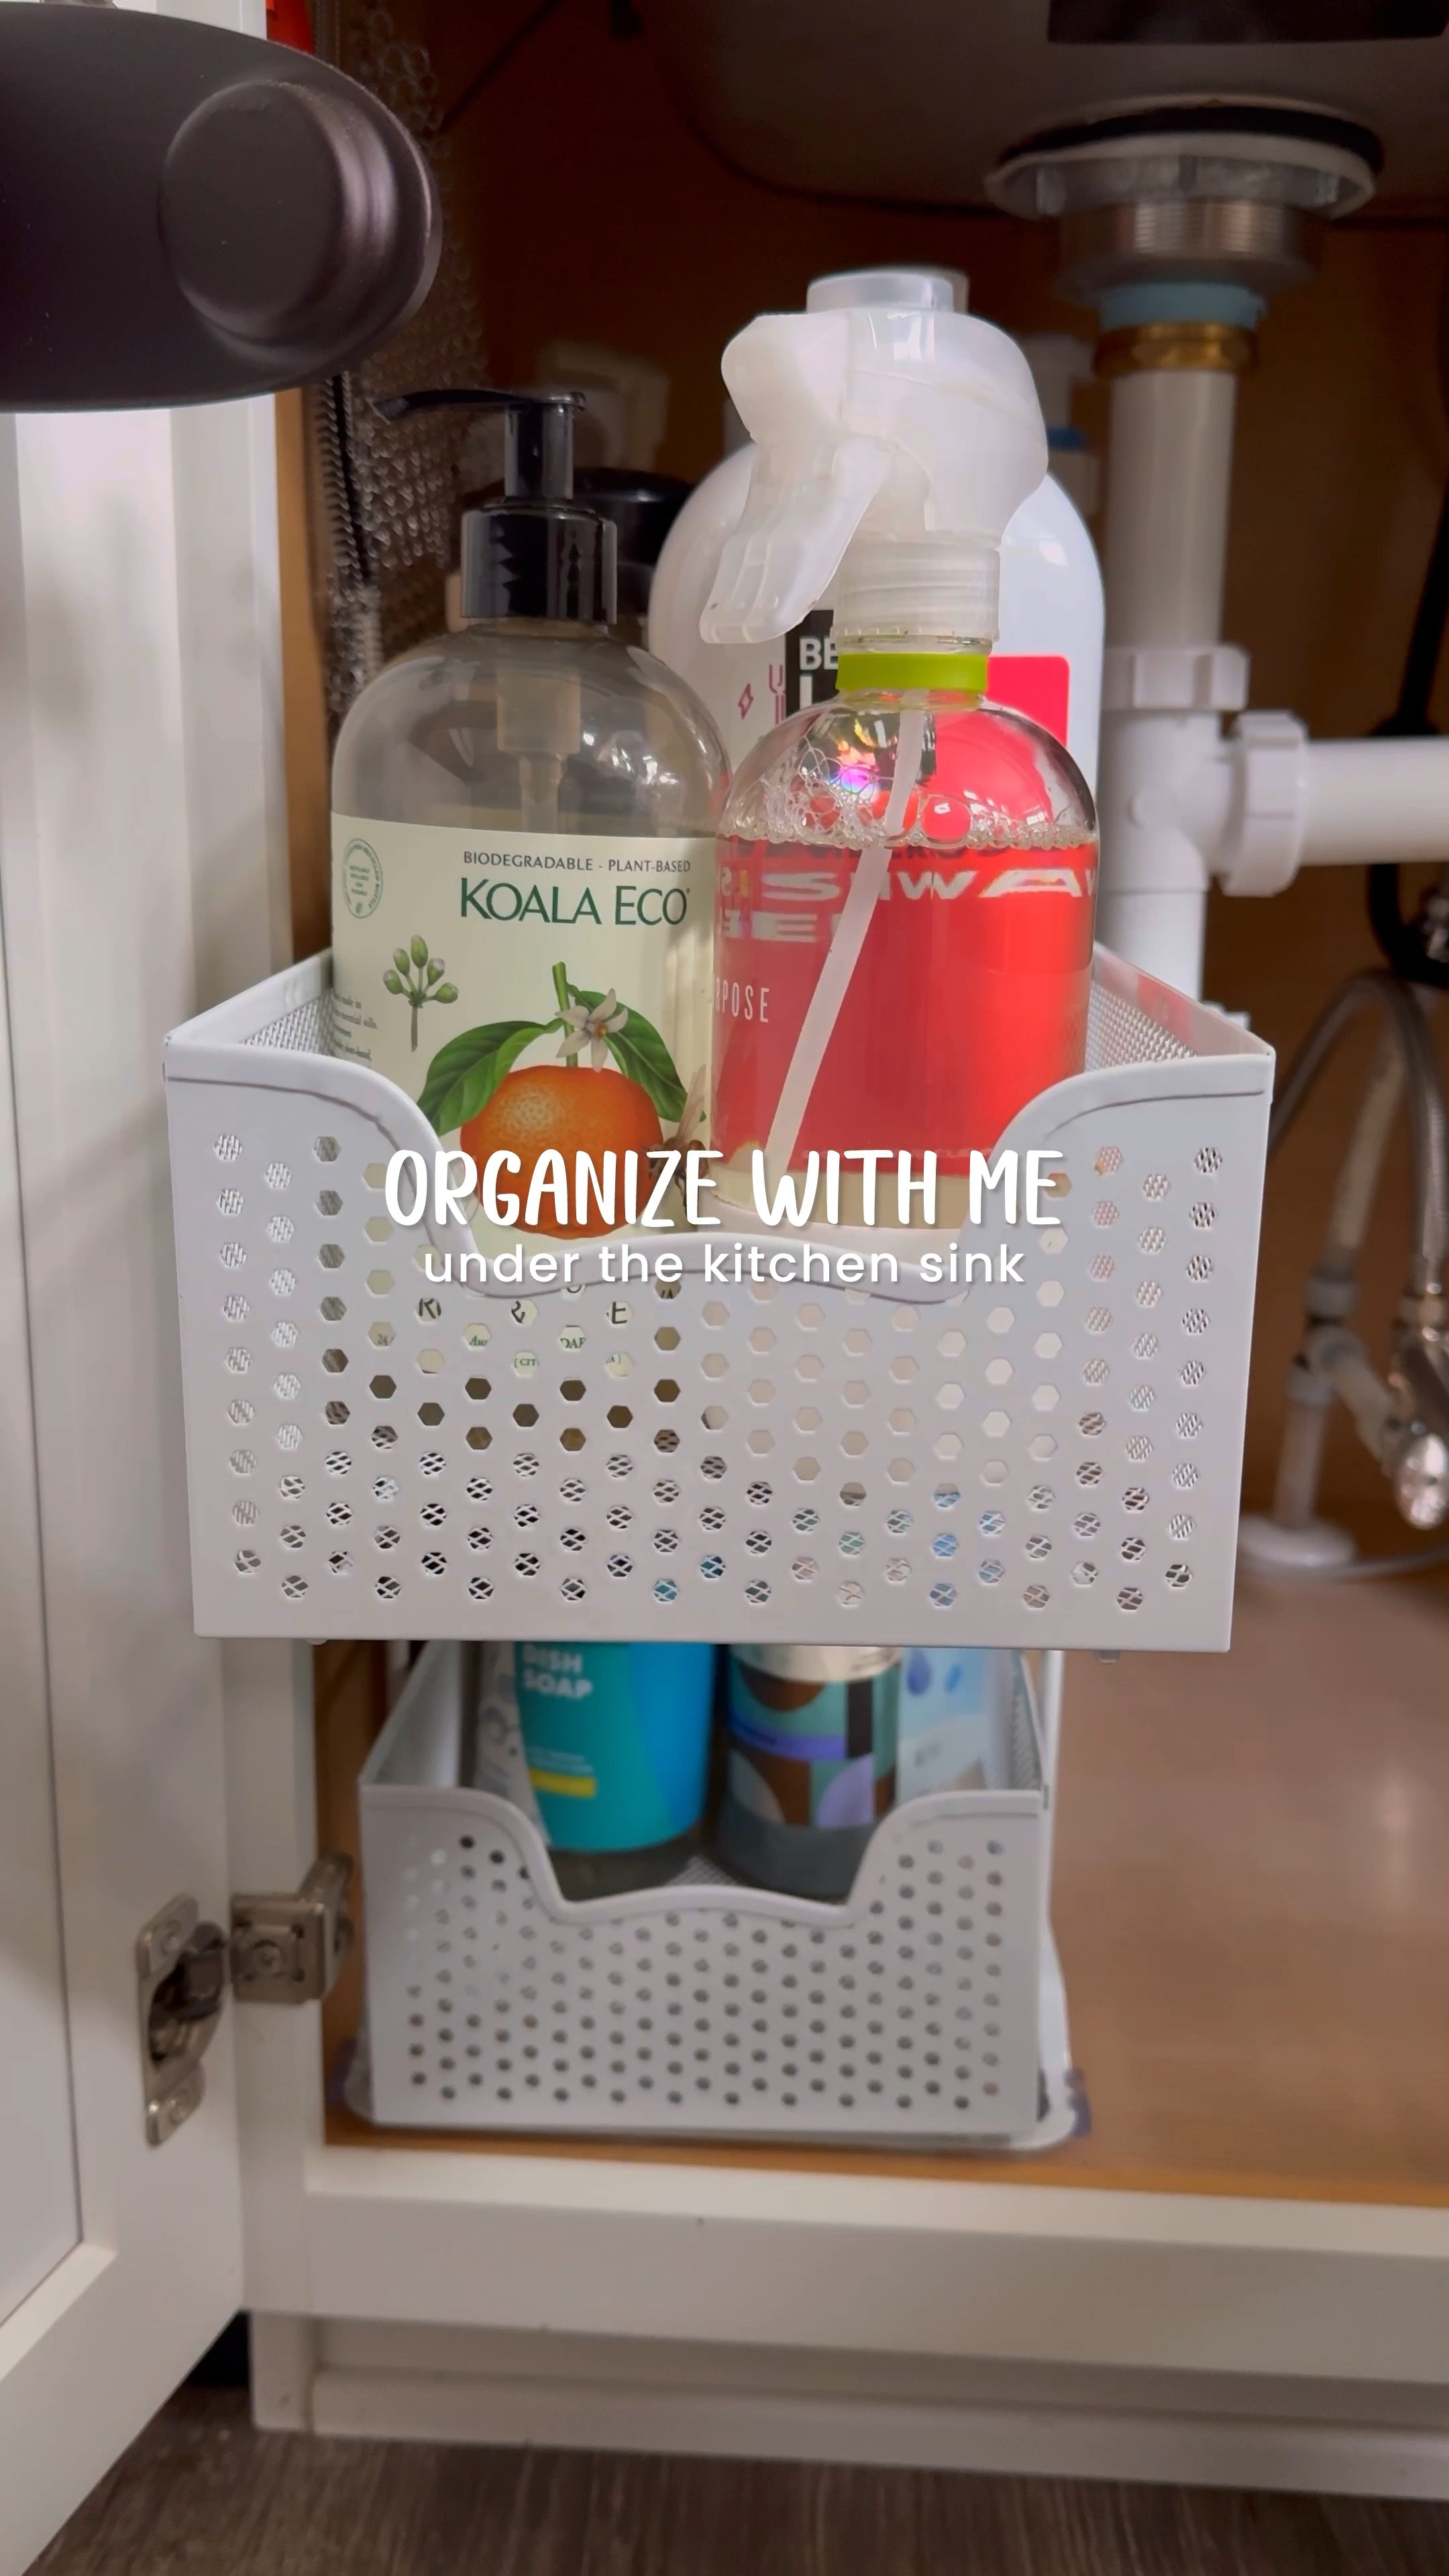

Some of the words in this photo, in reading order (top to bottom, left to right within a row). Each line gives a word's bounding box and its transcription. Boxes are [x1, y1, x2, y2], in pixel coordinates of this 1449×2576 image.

[464, 851, 594, 871] BIODEGRADABLE
[608, 859, 691, 873] PLANT-BASED
[461, 877, 602, 925] KOALA
[523, 1644, 583, 1674] DISH
[523, 1668, 593, 1701] SOAP
